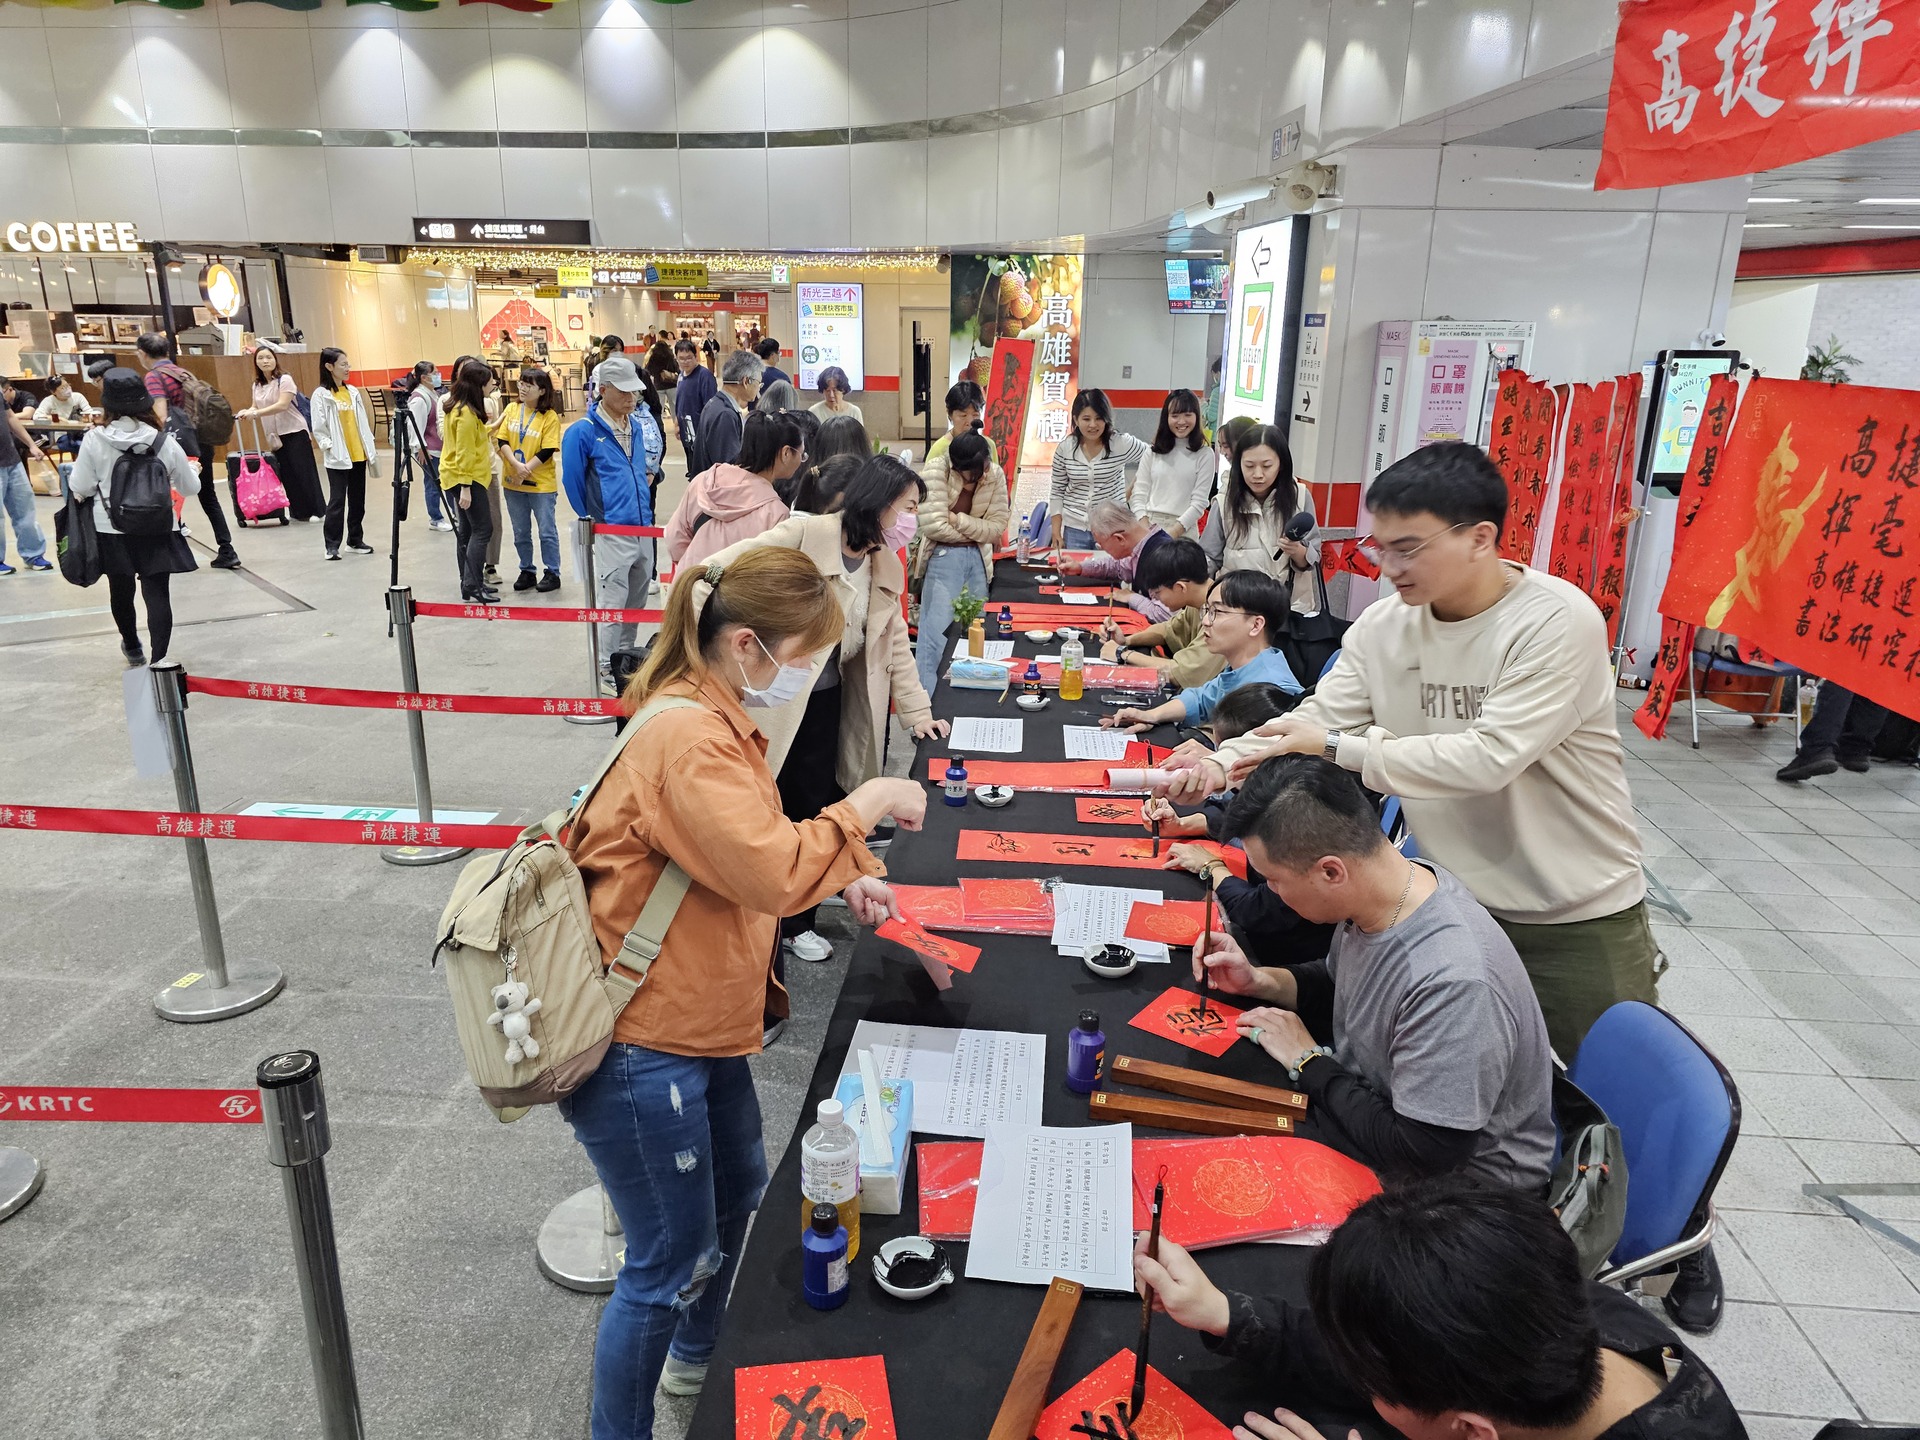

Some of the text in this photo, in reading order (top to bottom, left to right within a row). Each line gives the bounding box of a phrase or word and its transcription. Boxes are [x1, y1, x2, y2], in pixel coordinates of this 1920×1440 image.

[7, 222, 138, 252] COFFEE
[802, 288, 842, 299] 新光三越
[1036, 291, 1074, 443] 高雄賀禮
[1432, 364, 1467, 380] 口罩
[1430, 383, 1465, 395] 販賣機
[1821, 488, 1903, 558] 揮毫
[1807, 549, 1917, 618] 高雄捷運
[464, 606, 511, 619] 高雄捷運
[577, 610, 625, 623] 高雄捷運
[247, 683, 307, 702] 高雄捷運
[396, 694, 455, 713] 高雄捷運
[542, 699, 604, 715] 高雄捷運
[156, 815, 236, 839] 高雄捷運
[361, 822, 443, 845] 高雄捷運
[17, 1096, 94, 1112] KRTC
